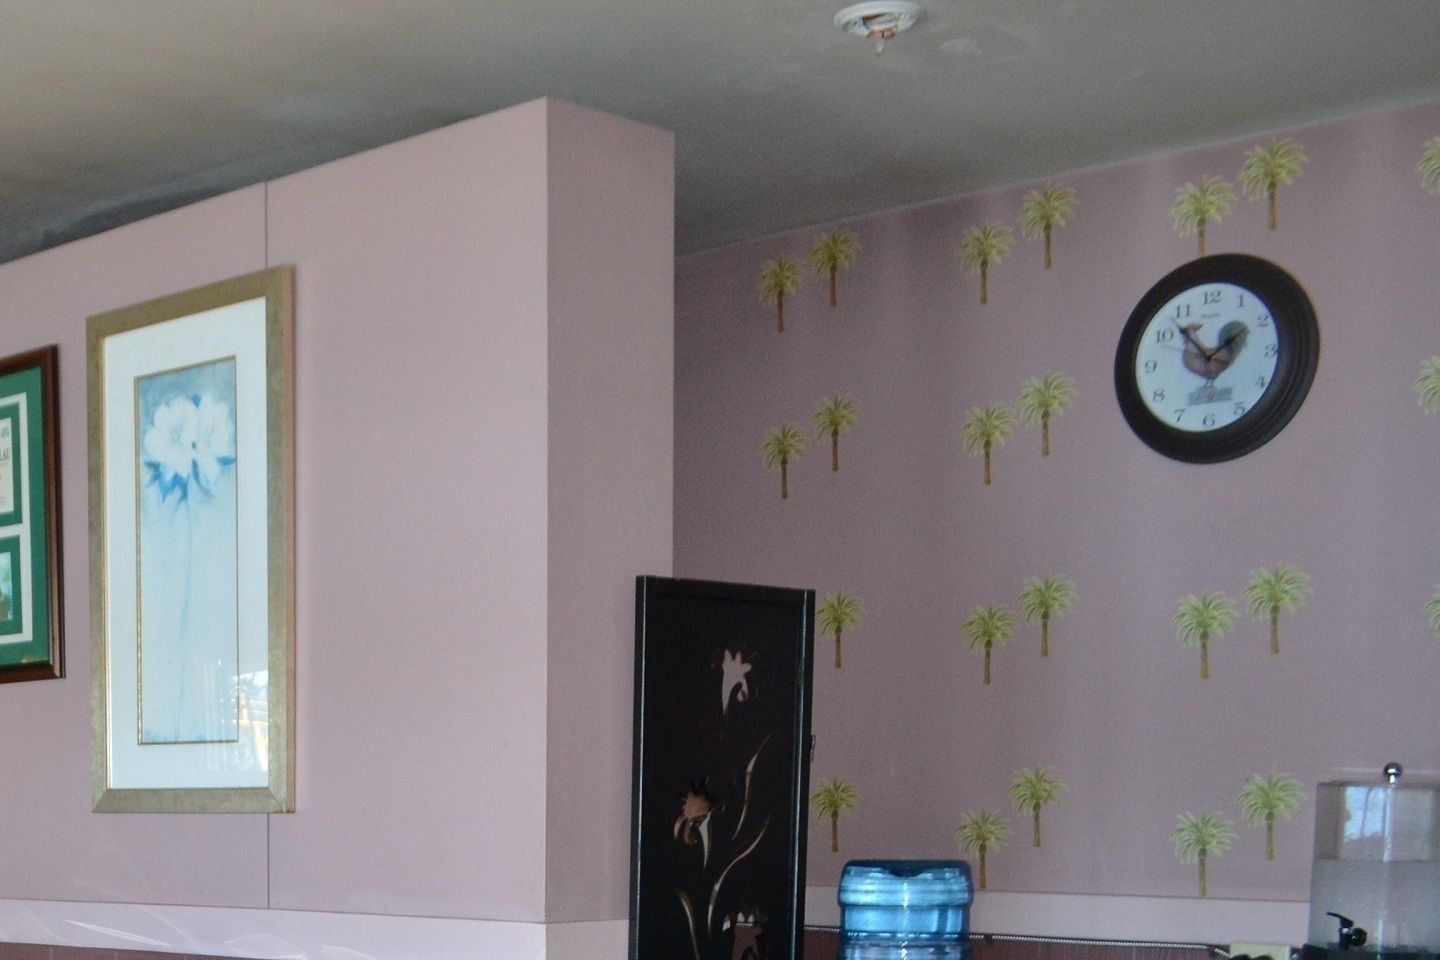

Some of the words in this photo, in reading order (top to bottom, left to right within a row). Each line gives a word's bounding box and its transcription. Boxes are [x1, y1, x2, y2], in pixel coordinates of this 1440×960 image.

[1202, 289, 1222, 306] 12
[1237, 295, 1246, 307] 1
[1175, 304, 1191, 318] 11
[1257, 315, 1269, 328] 2
[1156, 328, 1175, 343] 10
[1264, 344, 1278, 357] 3
[1144, 359, 1158, 373] 9
[1255, 375, 1266, 389] 4
[1152, 389, 1165, 402] 8
[1174, 408, 1186, 423] 7
[1233, 402, 1246, 415] 5
[1202, 413, 1216, 427] 6
